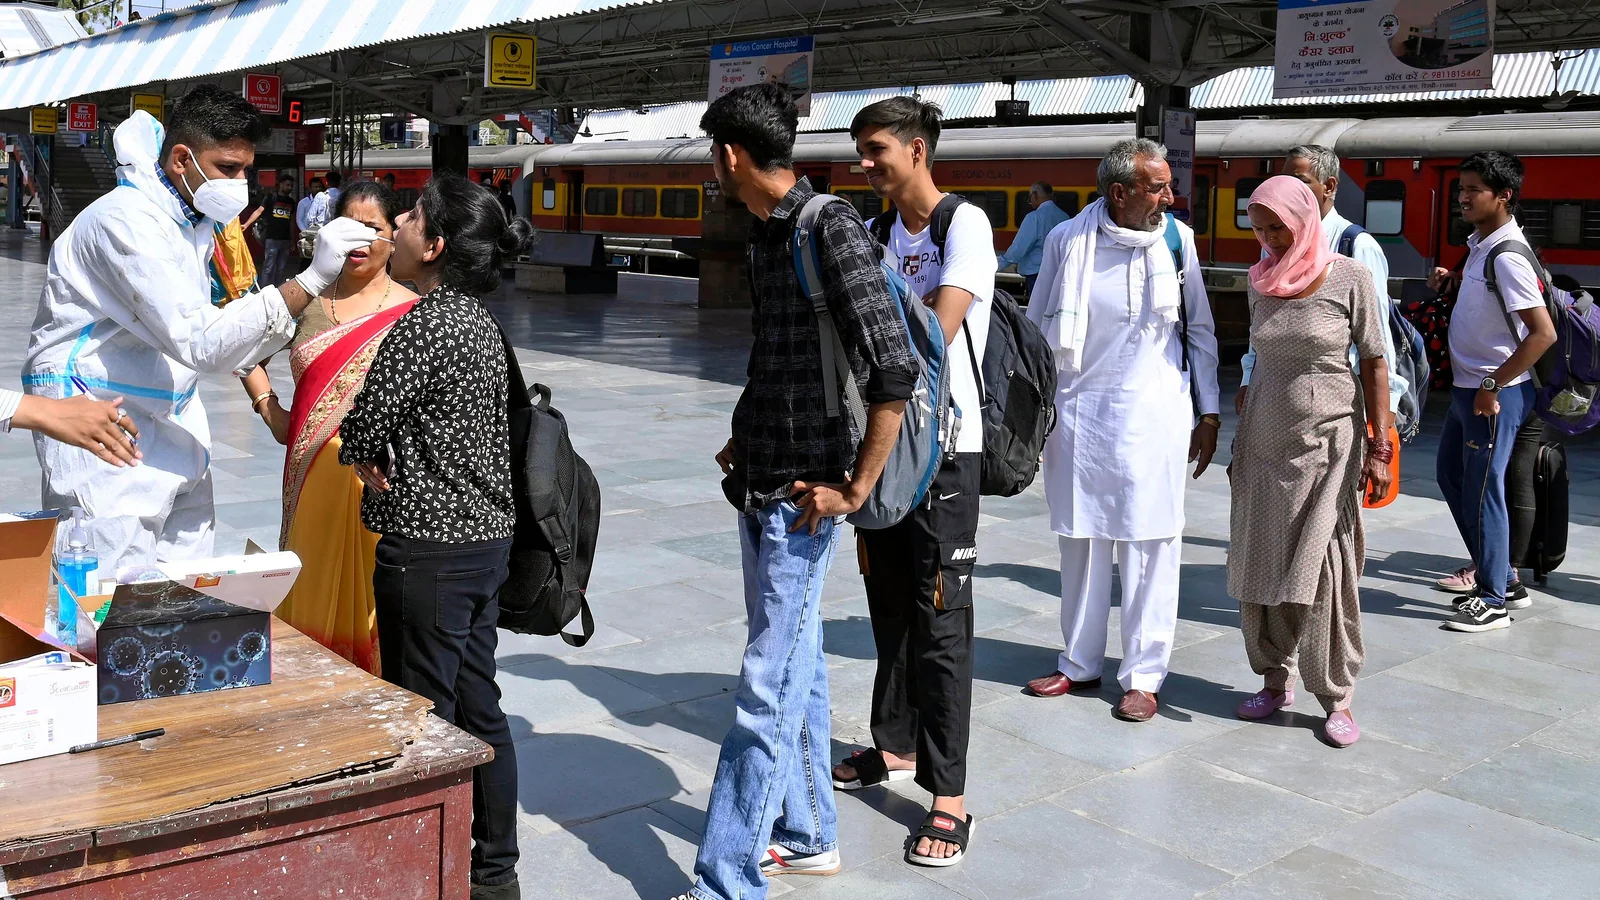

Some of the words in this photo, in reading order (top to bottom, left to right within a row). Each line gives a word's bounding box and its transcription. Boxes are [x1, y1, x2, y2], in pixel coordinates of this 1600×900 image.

[1297, 11, 1323, 20] आयुष्मान
[1326, 9, 1341, 17] भारत
[1344, 7, 1365, 15] योजना
[732, 44, 750, 52] Action
[751, 42, 772, 51] Cancer
[773, 39, 799, 50] Hospital
[1327, 45, 1354, 56] इलाज
[1384, 72, 1402, 81] कॉल
[1405, 71, 1418, 80] करें
[1431, 69, 1481, 79] 9811815442
[75, 113, 92, 121] बाहर
[289, 101, 301, 122] 6
[389, 122, 399, 138] 1
[952, 170, 985, 179] SECOND
[986, 170, 1012, 179] CLASS
